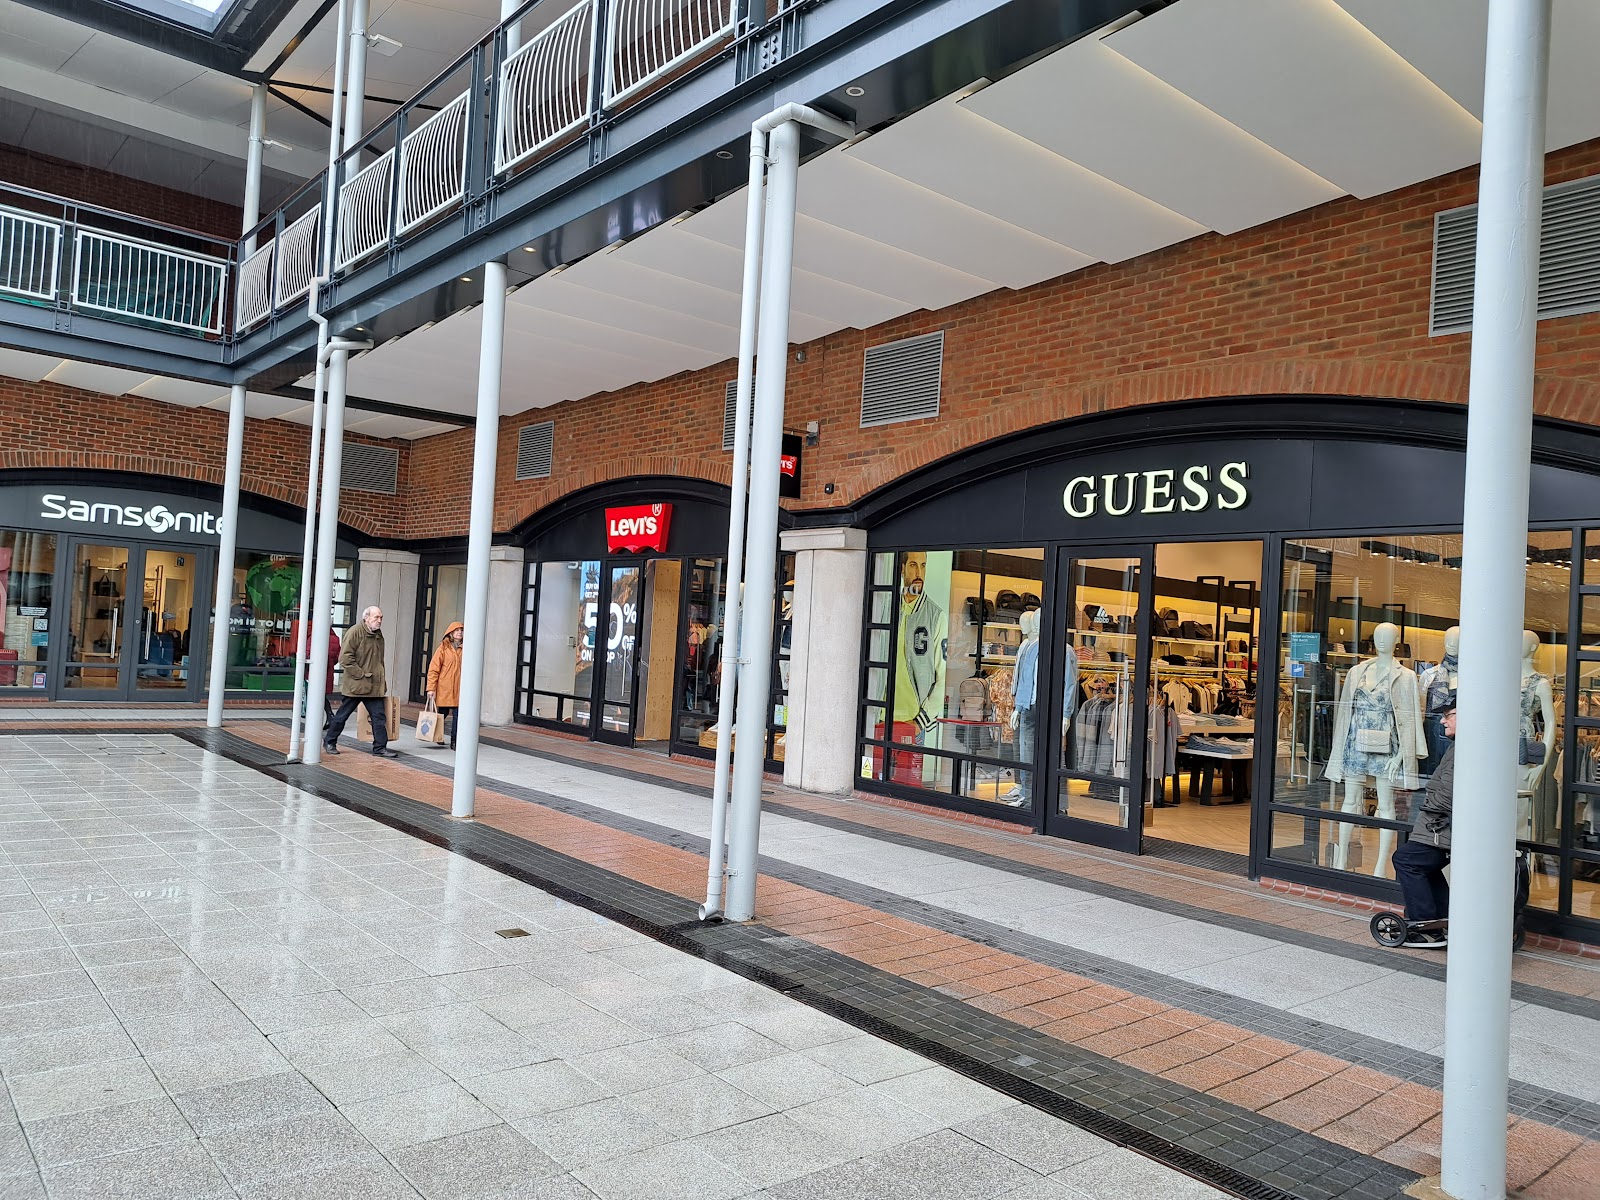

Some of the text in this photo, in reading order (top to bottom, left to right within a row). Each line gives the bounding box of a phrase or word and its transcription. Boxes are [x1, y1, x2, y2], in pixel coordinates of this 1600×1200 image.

[1062, 461, 1250, 519] GUESS
[258, 619, 275, 627] TO
[621, 634, 636, 651] OF
[913, 625, 930, 657] G
[581, 649, 592, 661] ON
